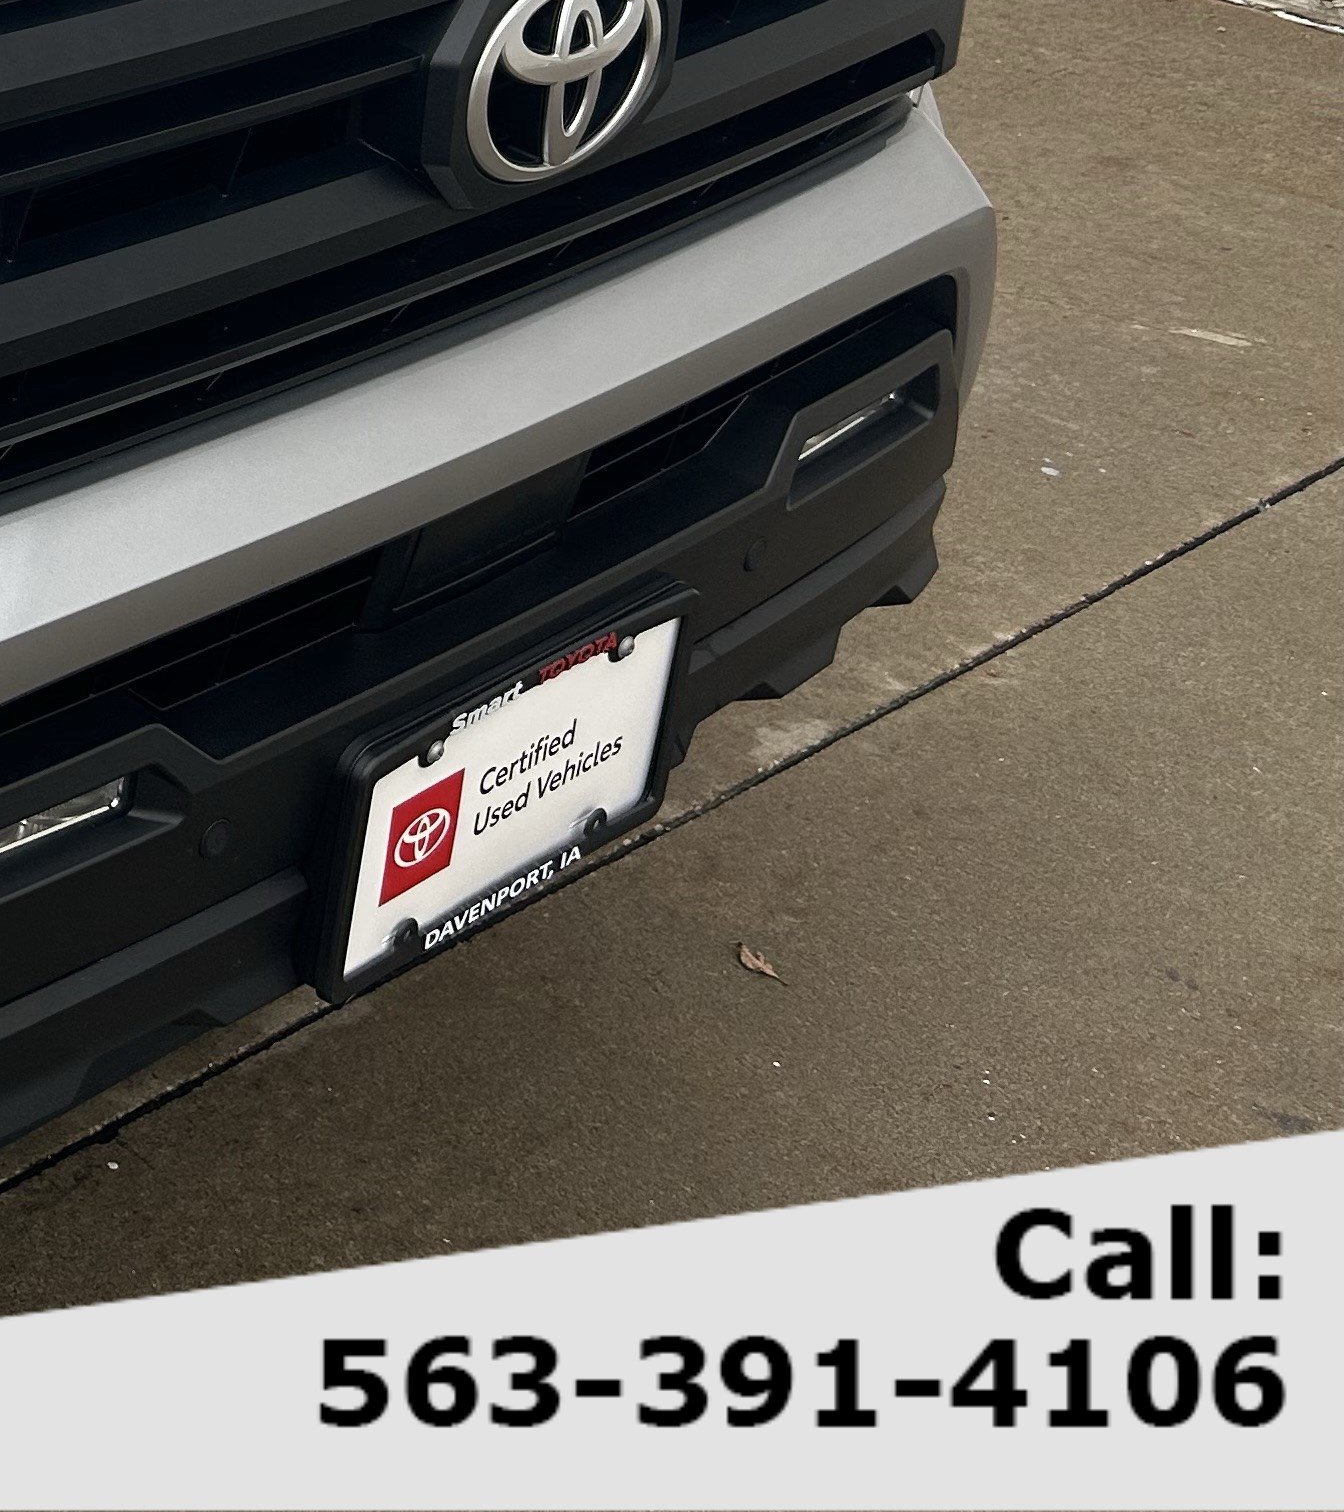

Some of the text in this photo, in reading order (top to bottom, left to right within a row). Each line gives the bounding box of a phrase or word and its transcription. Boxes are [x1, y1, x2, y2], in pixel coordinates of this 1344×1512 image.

[450, 631, 618, 737] Smart TOYOTA
[473, 734, 623, 836] Used Vehicles
[479, 718, 578, 795] Certified
[424, 845, 581, 950] DAVENPORT, IA
